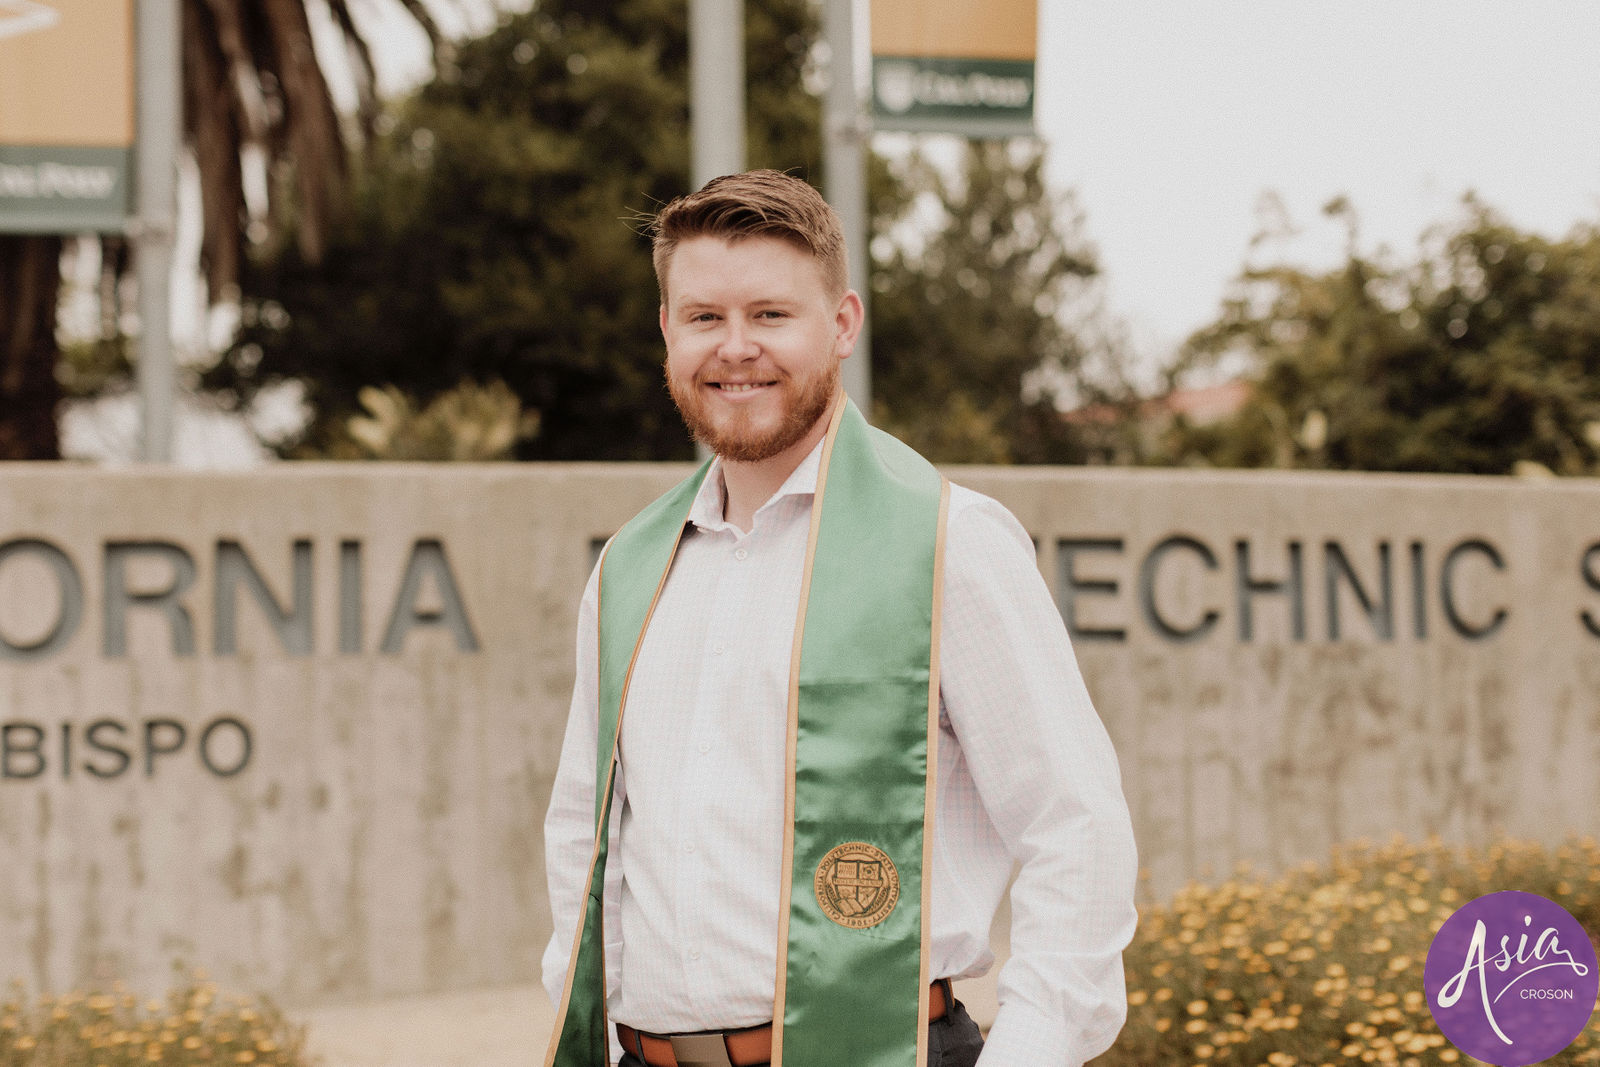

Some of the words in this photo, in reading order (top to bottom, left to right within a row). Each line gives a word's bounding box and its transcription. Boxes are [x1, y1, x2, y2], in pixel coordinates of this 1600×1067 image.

[0, 537, 480, 658] ORNIA
[1033, 535, 1508, 642] ECHNIC
[2, 716, 253, 779] BISPO
